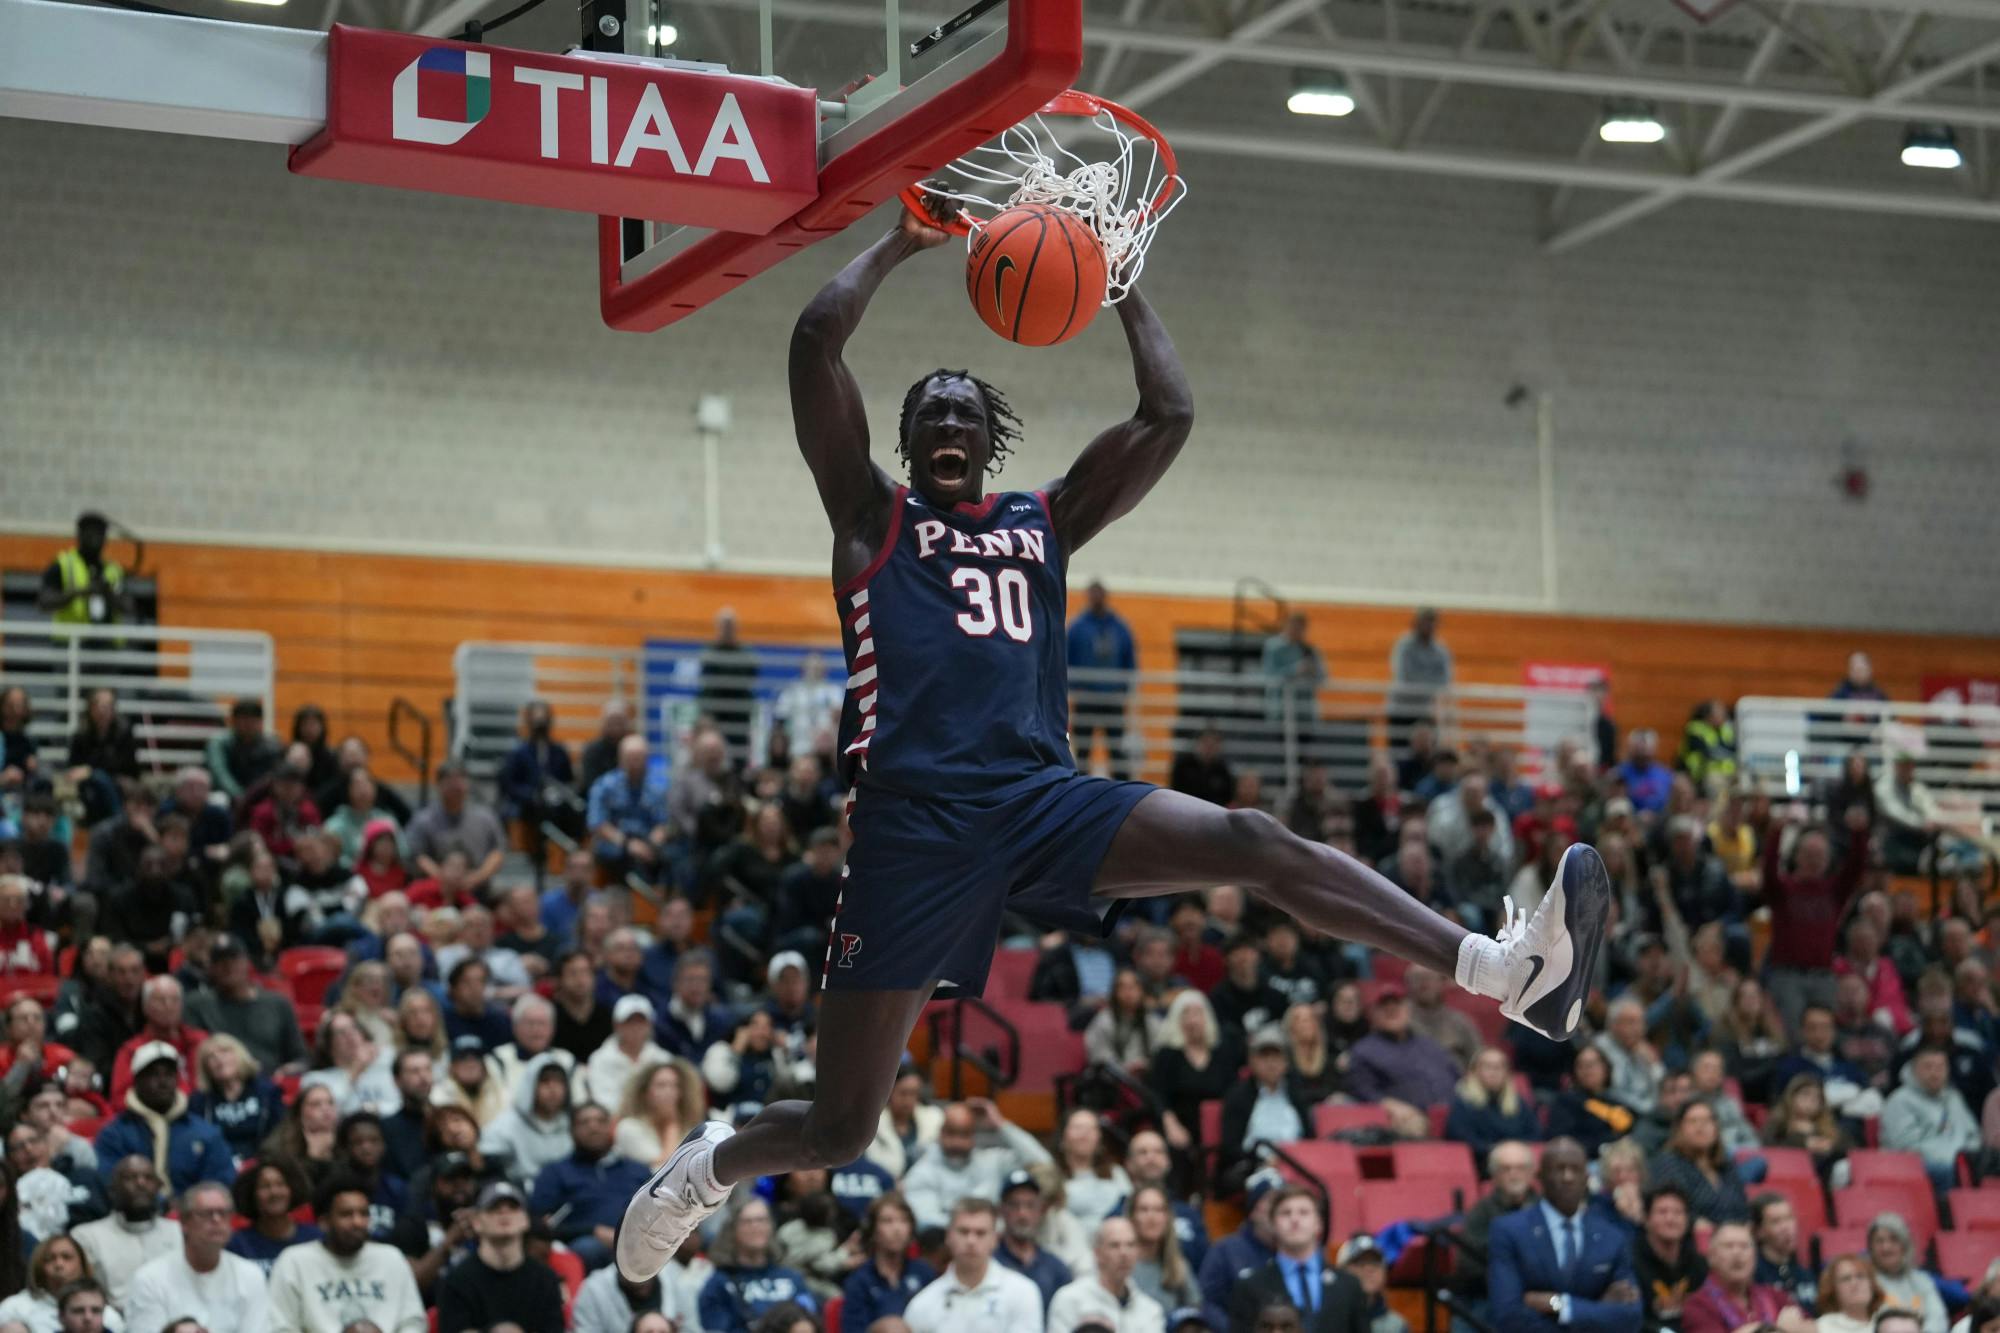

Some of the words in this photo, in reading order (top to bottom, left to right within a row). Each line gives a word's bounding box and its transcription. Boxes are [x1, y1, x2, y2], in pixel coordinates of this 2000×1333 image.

[513, 65, 771, 184] TIAA
[914, 519, 1046, 565] PENN
[950, 567, 1033, 643] 30
[837, 933, 863, 968] P
[316, 1279, 386, 1302] YALE
